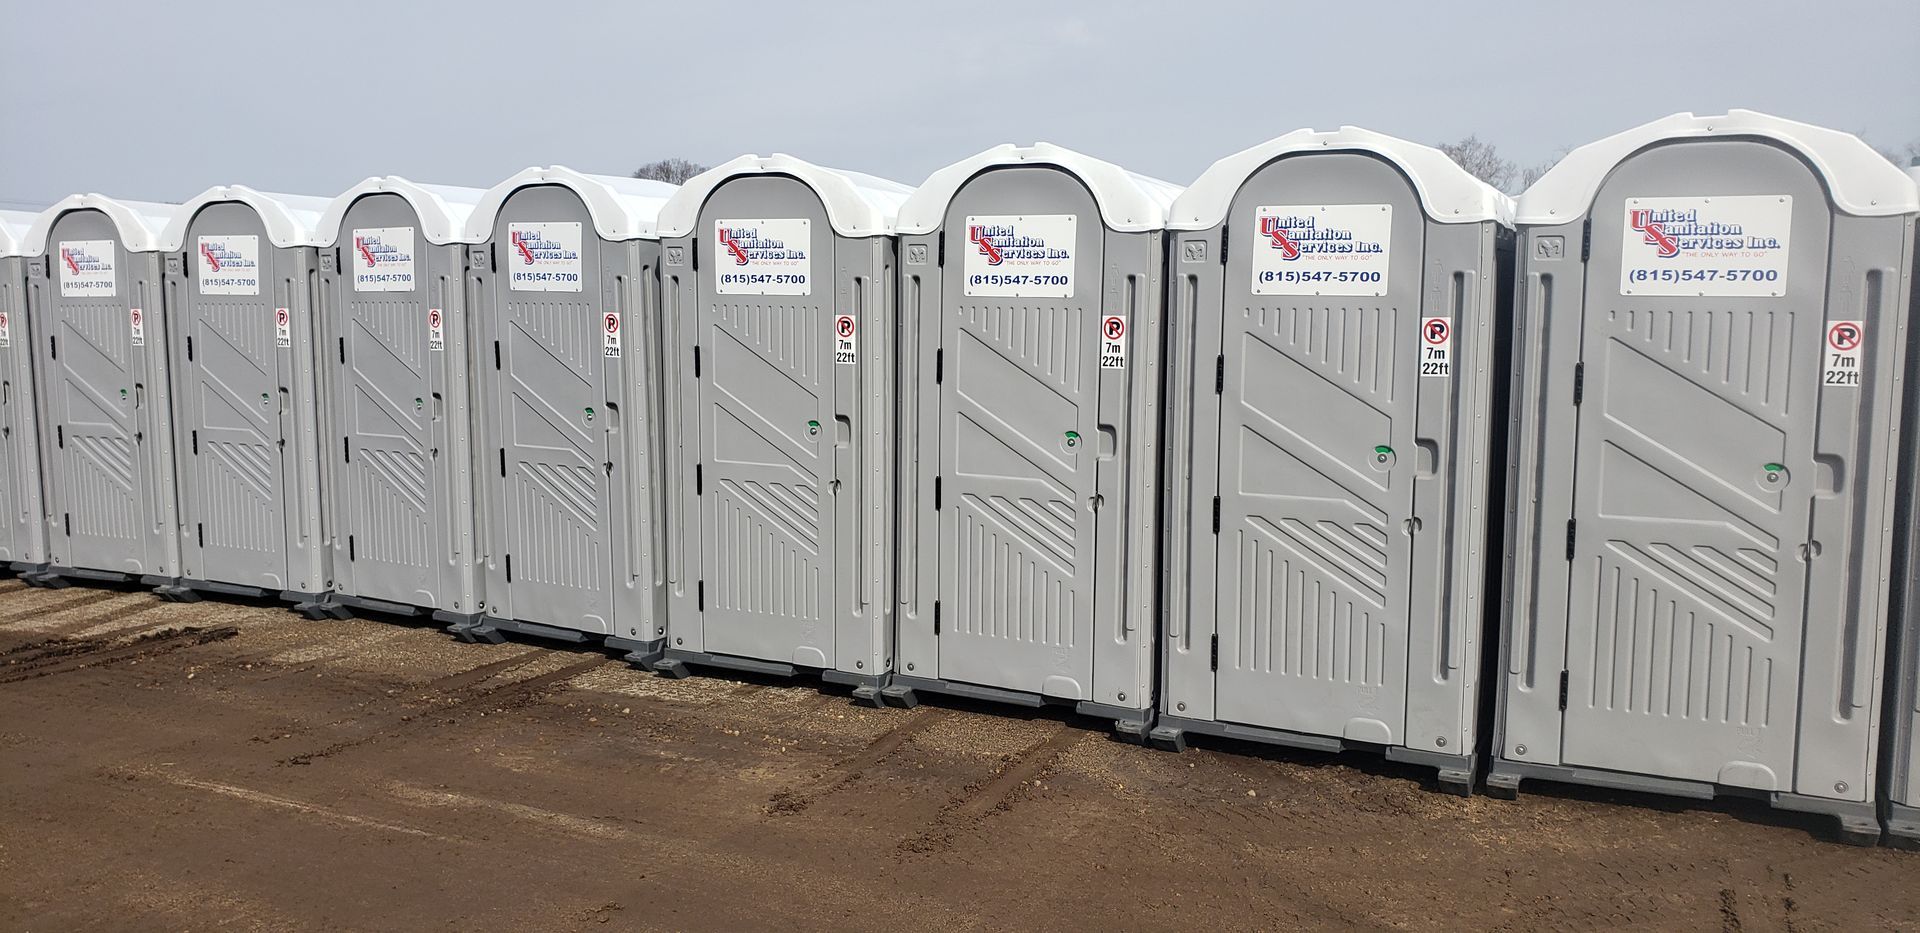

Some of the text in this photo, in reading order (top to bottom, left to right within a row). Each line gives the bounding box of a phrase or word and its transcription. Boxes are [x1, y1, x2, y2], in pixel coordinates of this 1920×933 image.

[1260, 216, 1315, 237] United
[1630, 209, 1696, 232] United
[718, 228, 757, 245] United
[969, 225, 1014, 244] United
[1272, 228, 1351, 249] Sanitation
[1644, 222, 1742, 245] Sanitation
[728, 239, 784, 256] Sanitation
[979, 236, 1044, 255] Sanitation
[1282, 240, 1383, 260] Services Inc.
[1657, 236, 1781, 258] Services Inc.
[736, 250, 806, 266] Services Inc.
[988, 248, 1070, 266] Services Inc.
[202, 278, 256, 287] (815)547-5700
[358, 274, 411, 283] (815)547-5700
[513, 273, 578, 282] (815)547-5700
[720, 274, 806, 285] (815)547-5700
[969, 275, 1068, 286] (815)547-5700
[1259, 271, 1381, 284] (815)547-5700
[1629, 269, 1778, 284] (815)547-5700
[64, 282, 112, 290] (815)547-5700
[432, 330, 440, 338] 7m
[607, 335, 617, 344] 7m
[430, 341, 442, 350] 22ft
[605, 346, 620, 356] 22ft
[839, 340, 851, 350] 7m
[1106, 342, 1120, 353] 7m
[836, 352, 855, 362] 22ft
[1426, 347, 1445, 359] 7m
[1102, 356, 1123, 367] 22ft
[1831, 354, 1855, 367] 7m
[1422, 363, 1448, 375] 22ft
[1826, 371, 1859, 384] 22ft
